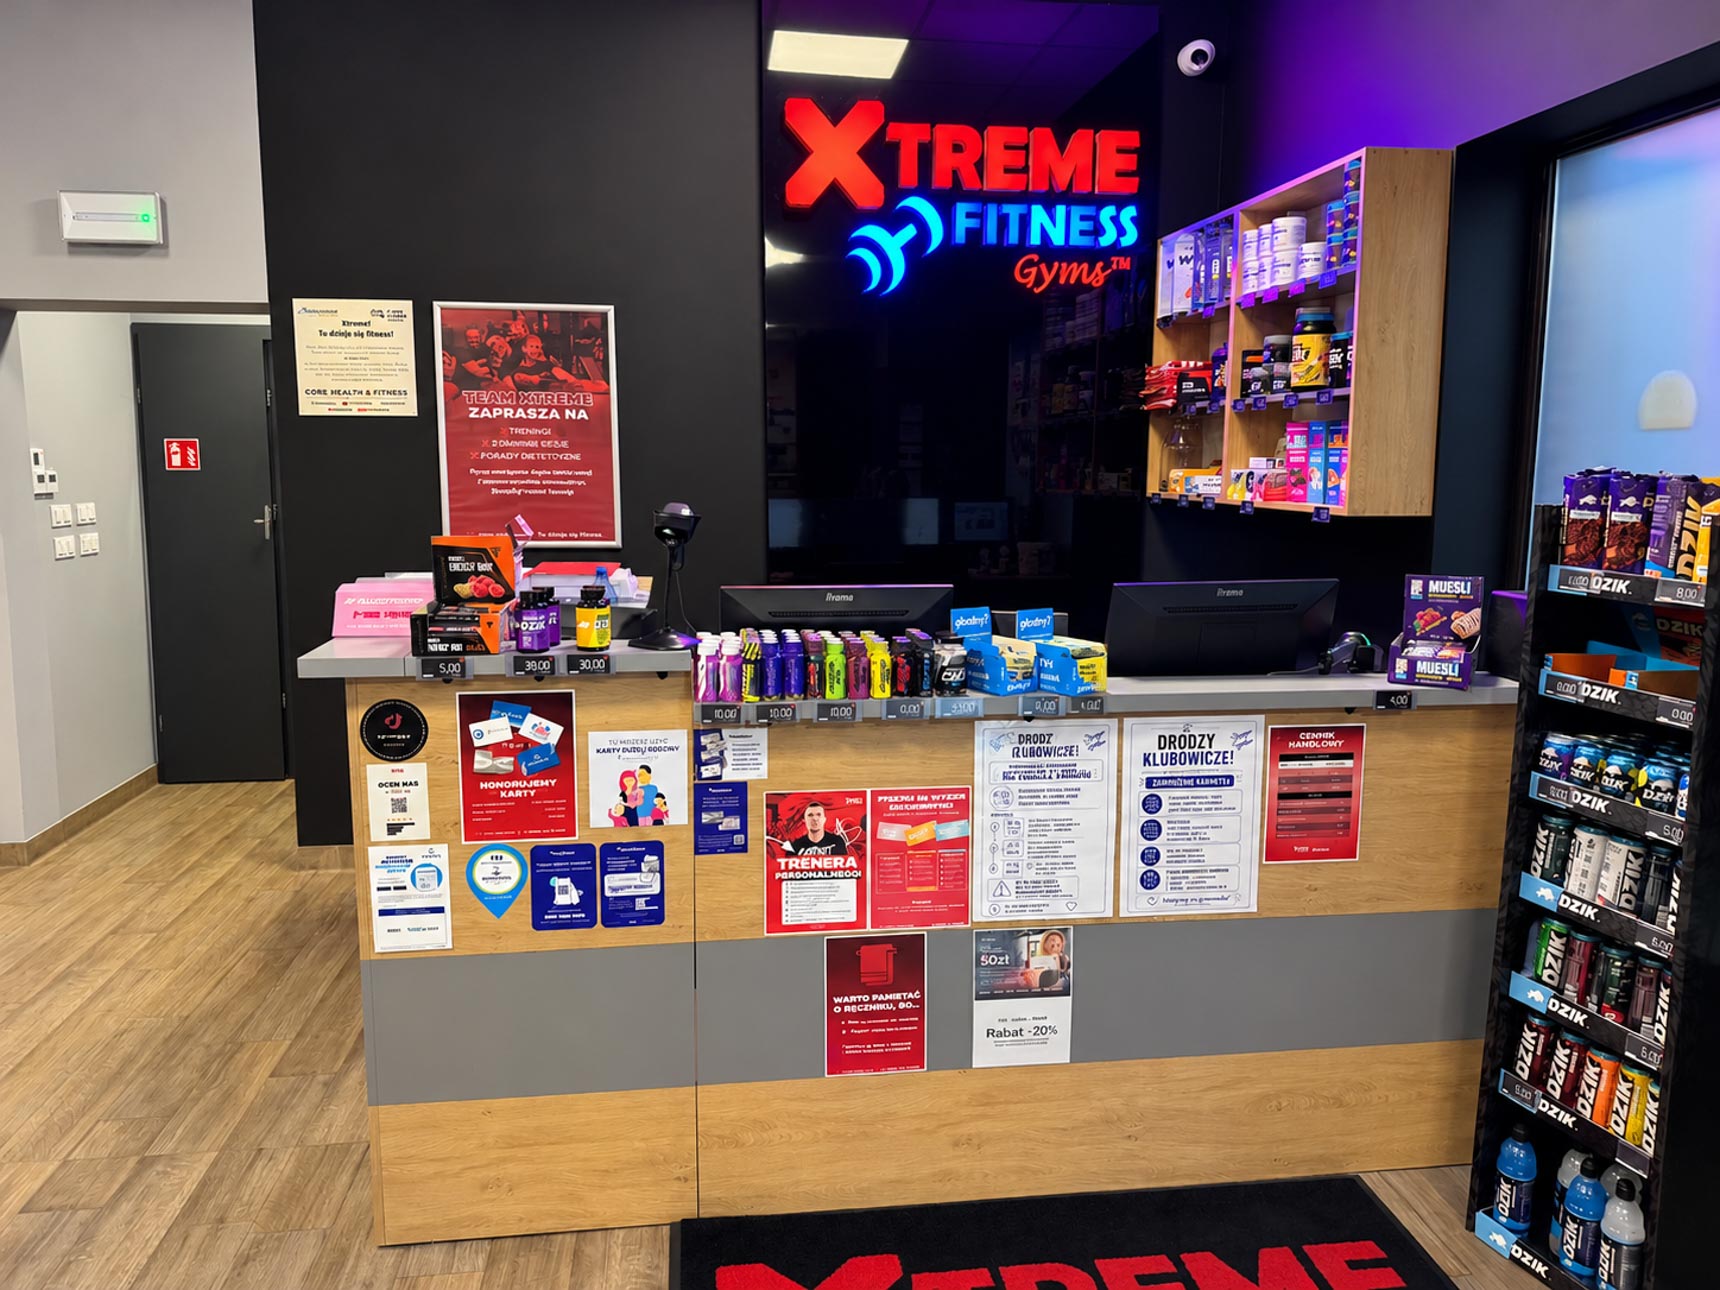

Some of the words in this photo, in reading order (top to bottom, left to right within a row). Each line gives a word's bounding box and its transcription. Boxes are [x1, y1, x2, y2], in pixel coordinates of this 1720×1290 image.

[784, 98, 1140, 209] XTREME
[953, 202, 1138, 248] FITNESS
[462, 391, 515, 405] TEAM
[519, 392, 593, 406] XTREME
[469, 407, 560, 419] ZAPRASZA
[565, 409, 588, 420] NA
[1429, 580, 1471, 594] MUESLI
[1656, 618, 1703, 636] DZIK
[1416, 660, 1459, 677] MUESLI
[1158, 734, 1215, 750] DRODZY
[1299, 731, 1336, 740] CENNIK
[1143, 751, 1234, 767] KLUBOWICZE!
[480, 779, 557, 789] HONORUJEMY
[500, 790, 536, 798] KARTY
[777, 857, 858, 870] TRENERA
[1619, 848, 1646, 911] DZIK
[1542, 931, 1568, 987] DZIK
[833, 995, 870, 1003] WARTO
[986, 1028, 1024, 1038] Rabat
[1028, 1025, 1057, 1036] -20%
[1515, 1023, 1538, 1081] DZIK
[1546, 1039, 1571, 1099] DZIK
[1577, 1055, 1602, 1119] DZIK
[1610, 1073, 1634, 1136] DZIK
